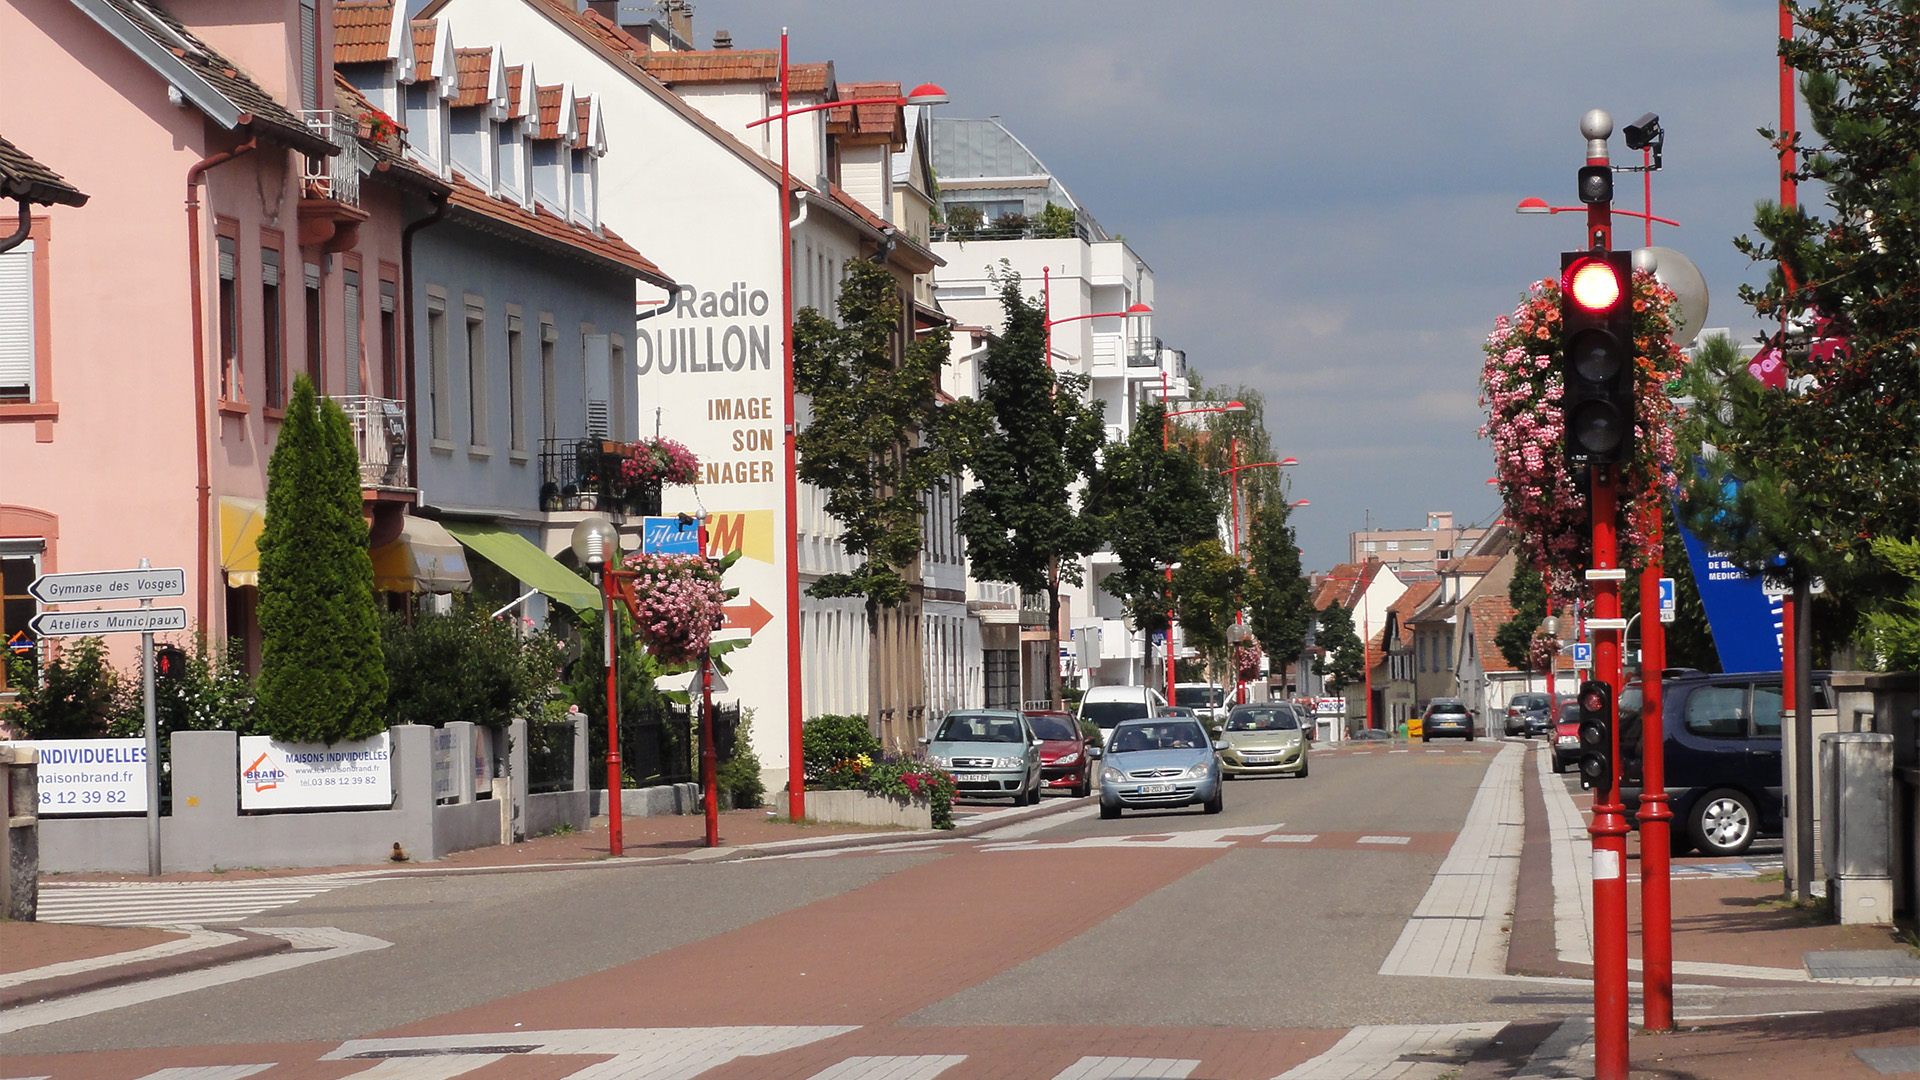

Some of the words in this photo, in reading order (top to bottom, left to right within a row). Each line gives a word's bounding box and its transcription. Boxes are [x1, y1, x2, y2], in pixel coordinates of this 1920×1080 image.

[677, 282, 769, 319] Radio
[637, 324, 771, 376] OUILLON
[708, 397, 772, 421] IMAGE
[732, 429, 773, 452] SON
[50, 583, 103, 596] Gymnase
[109, 580, 130, 592] des
[137, 579, 178, 592] Vosges
[49, 619, 100, 630] Ateliers
[106, 615, 179, 629] Municipaux
[285, 753, 325, 763] MAISONS
[326, 750, 388, 762] INDIVIDUELLES
[246, 770, 285, 779] BRAND
[324, 778, 336, 786] 88
[339, 777, 350, 785] 12
[352, 776, 363, 785] 39
[365, 776, 377, 785] 82
[57, 791, 77, 804] 12
[82, 791, 102, 804] 39
[106, 790, 127, 803] 82
